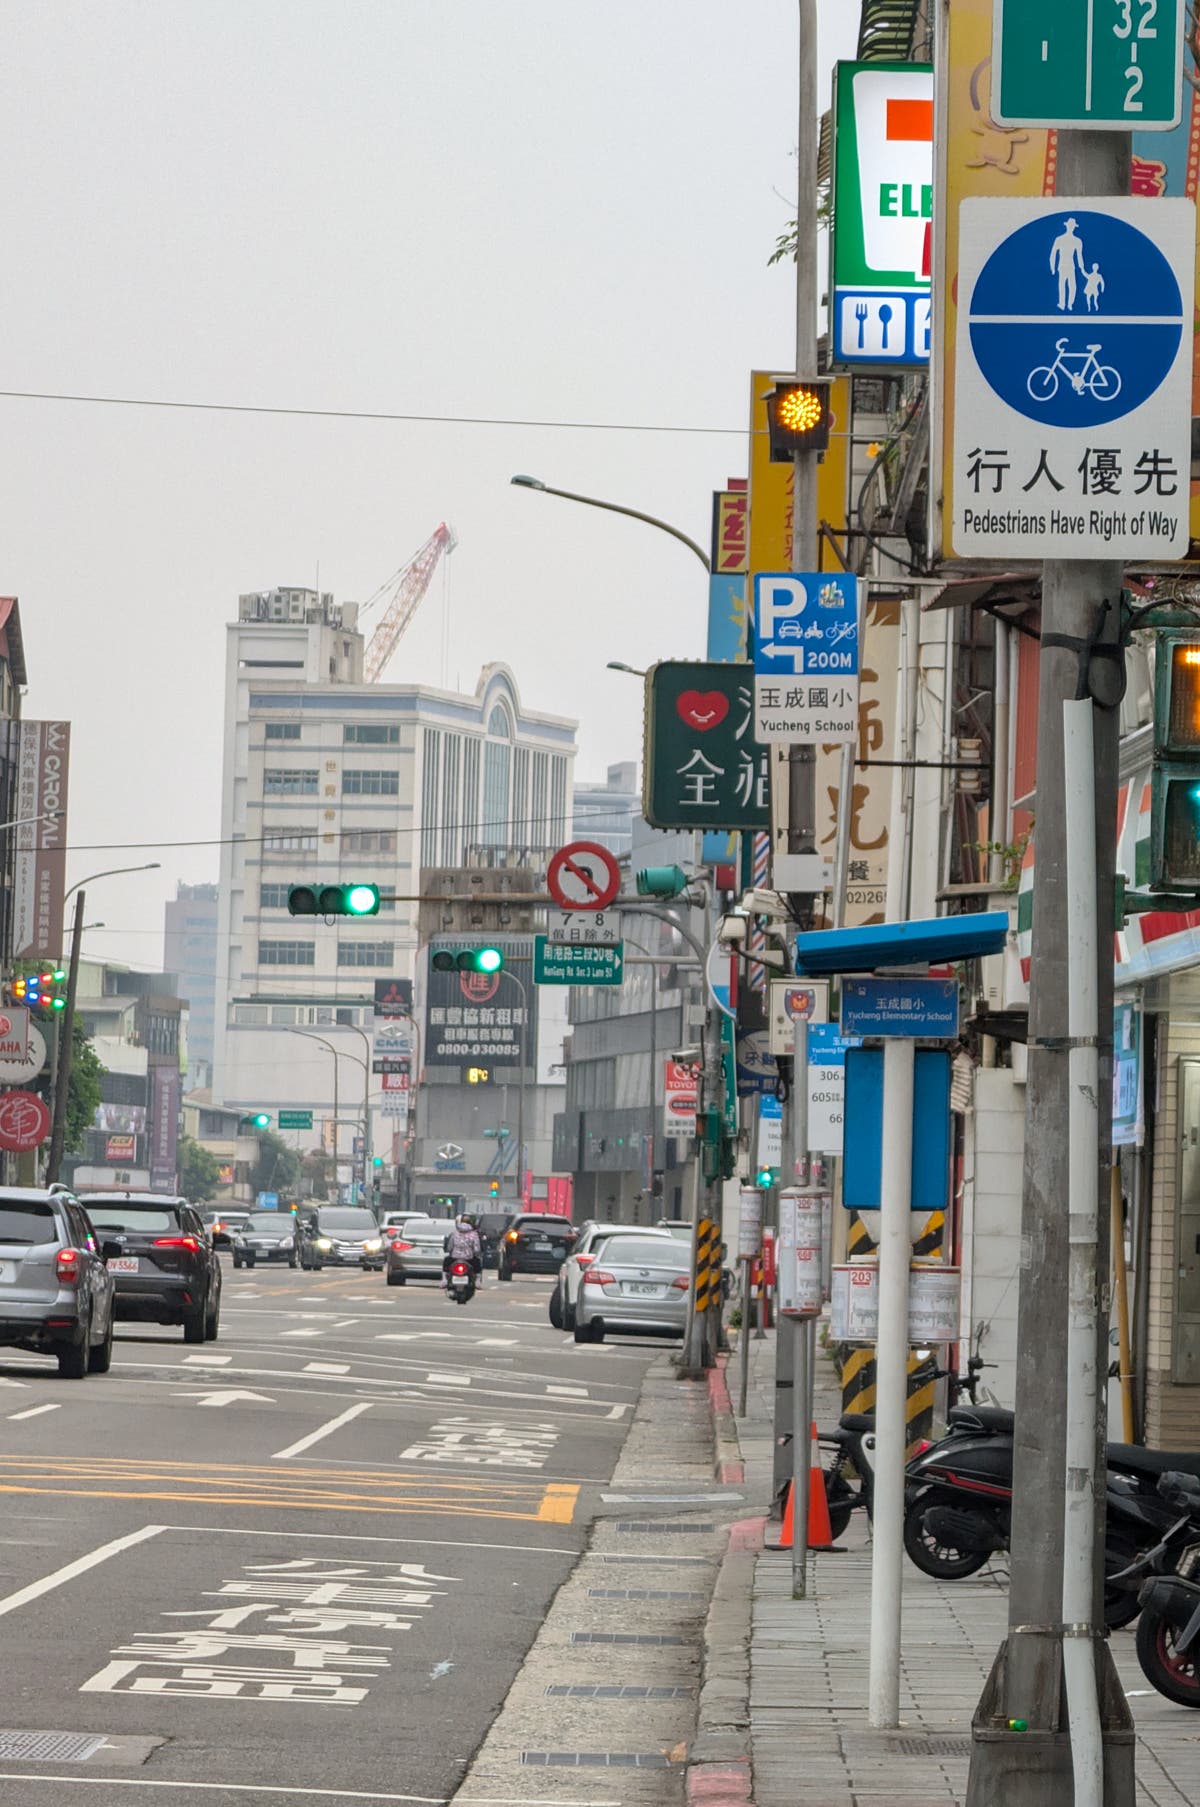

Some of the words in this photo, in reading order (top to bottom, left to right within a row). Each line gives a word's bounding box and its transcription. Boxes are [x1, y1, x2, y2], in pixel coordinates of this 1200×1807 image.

[965, 446, 1179, 497] 行人優先
[963, 508, 1047, 536] Pedestrians
[1050, 510, 1085, 536] Have
[1087, 510, 1127, 543] Right
[1130, 511, 1145, 536] of
[1147, 514, 1178, 543] Way
[759, 577, 808, 639] P
[807, 652, 852, 669] 200M
[760, 687, 853, 709] 玉成國小
[760, 720, 810, 734] Yucheng
[815, 719, 854, 732] School
[561, 912, 574, 926] 7
[595, 912, 605, 927] 8
[553, 928, 615, 941] 假日除外
[876, 998, 925, 1010] 玉成國小
[848, 1011, 881, 1021] Yucheng
[882, 1011, 926, 1021] Elementary
[927, 1011, 953, 1020] School
[375, 1039, 409, 1047] CMC
[437, 1044, 521, 1056] 0800-030085
[819, 1071, 840, 1081] 306
[811, 1092, 831, 1102] 605
[851, 1271, 872, 1282] 203
